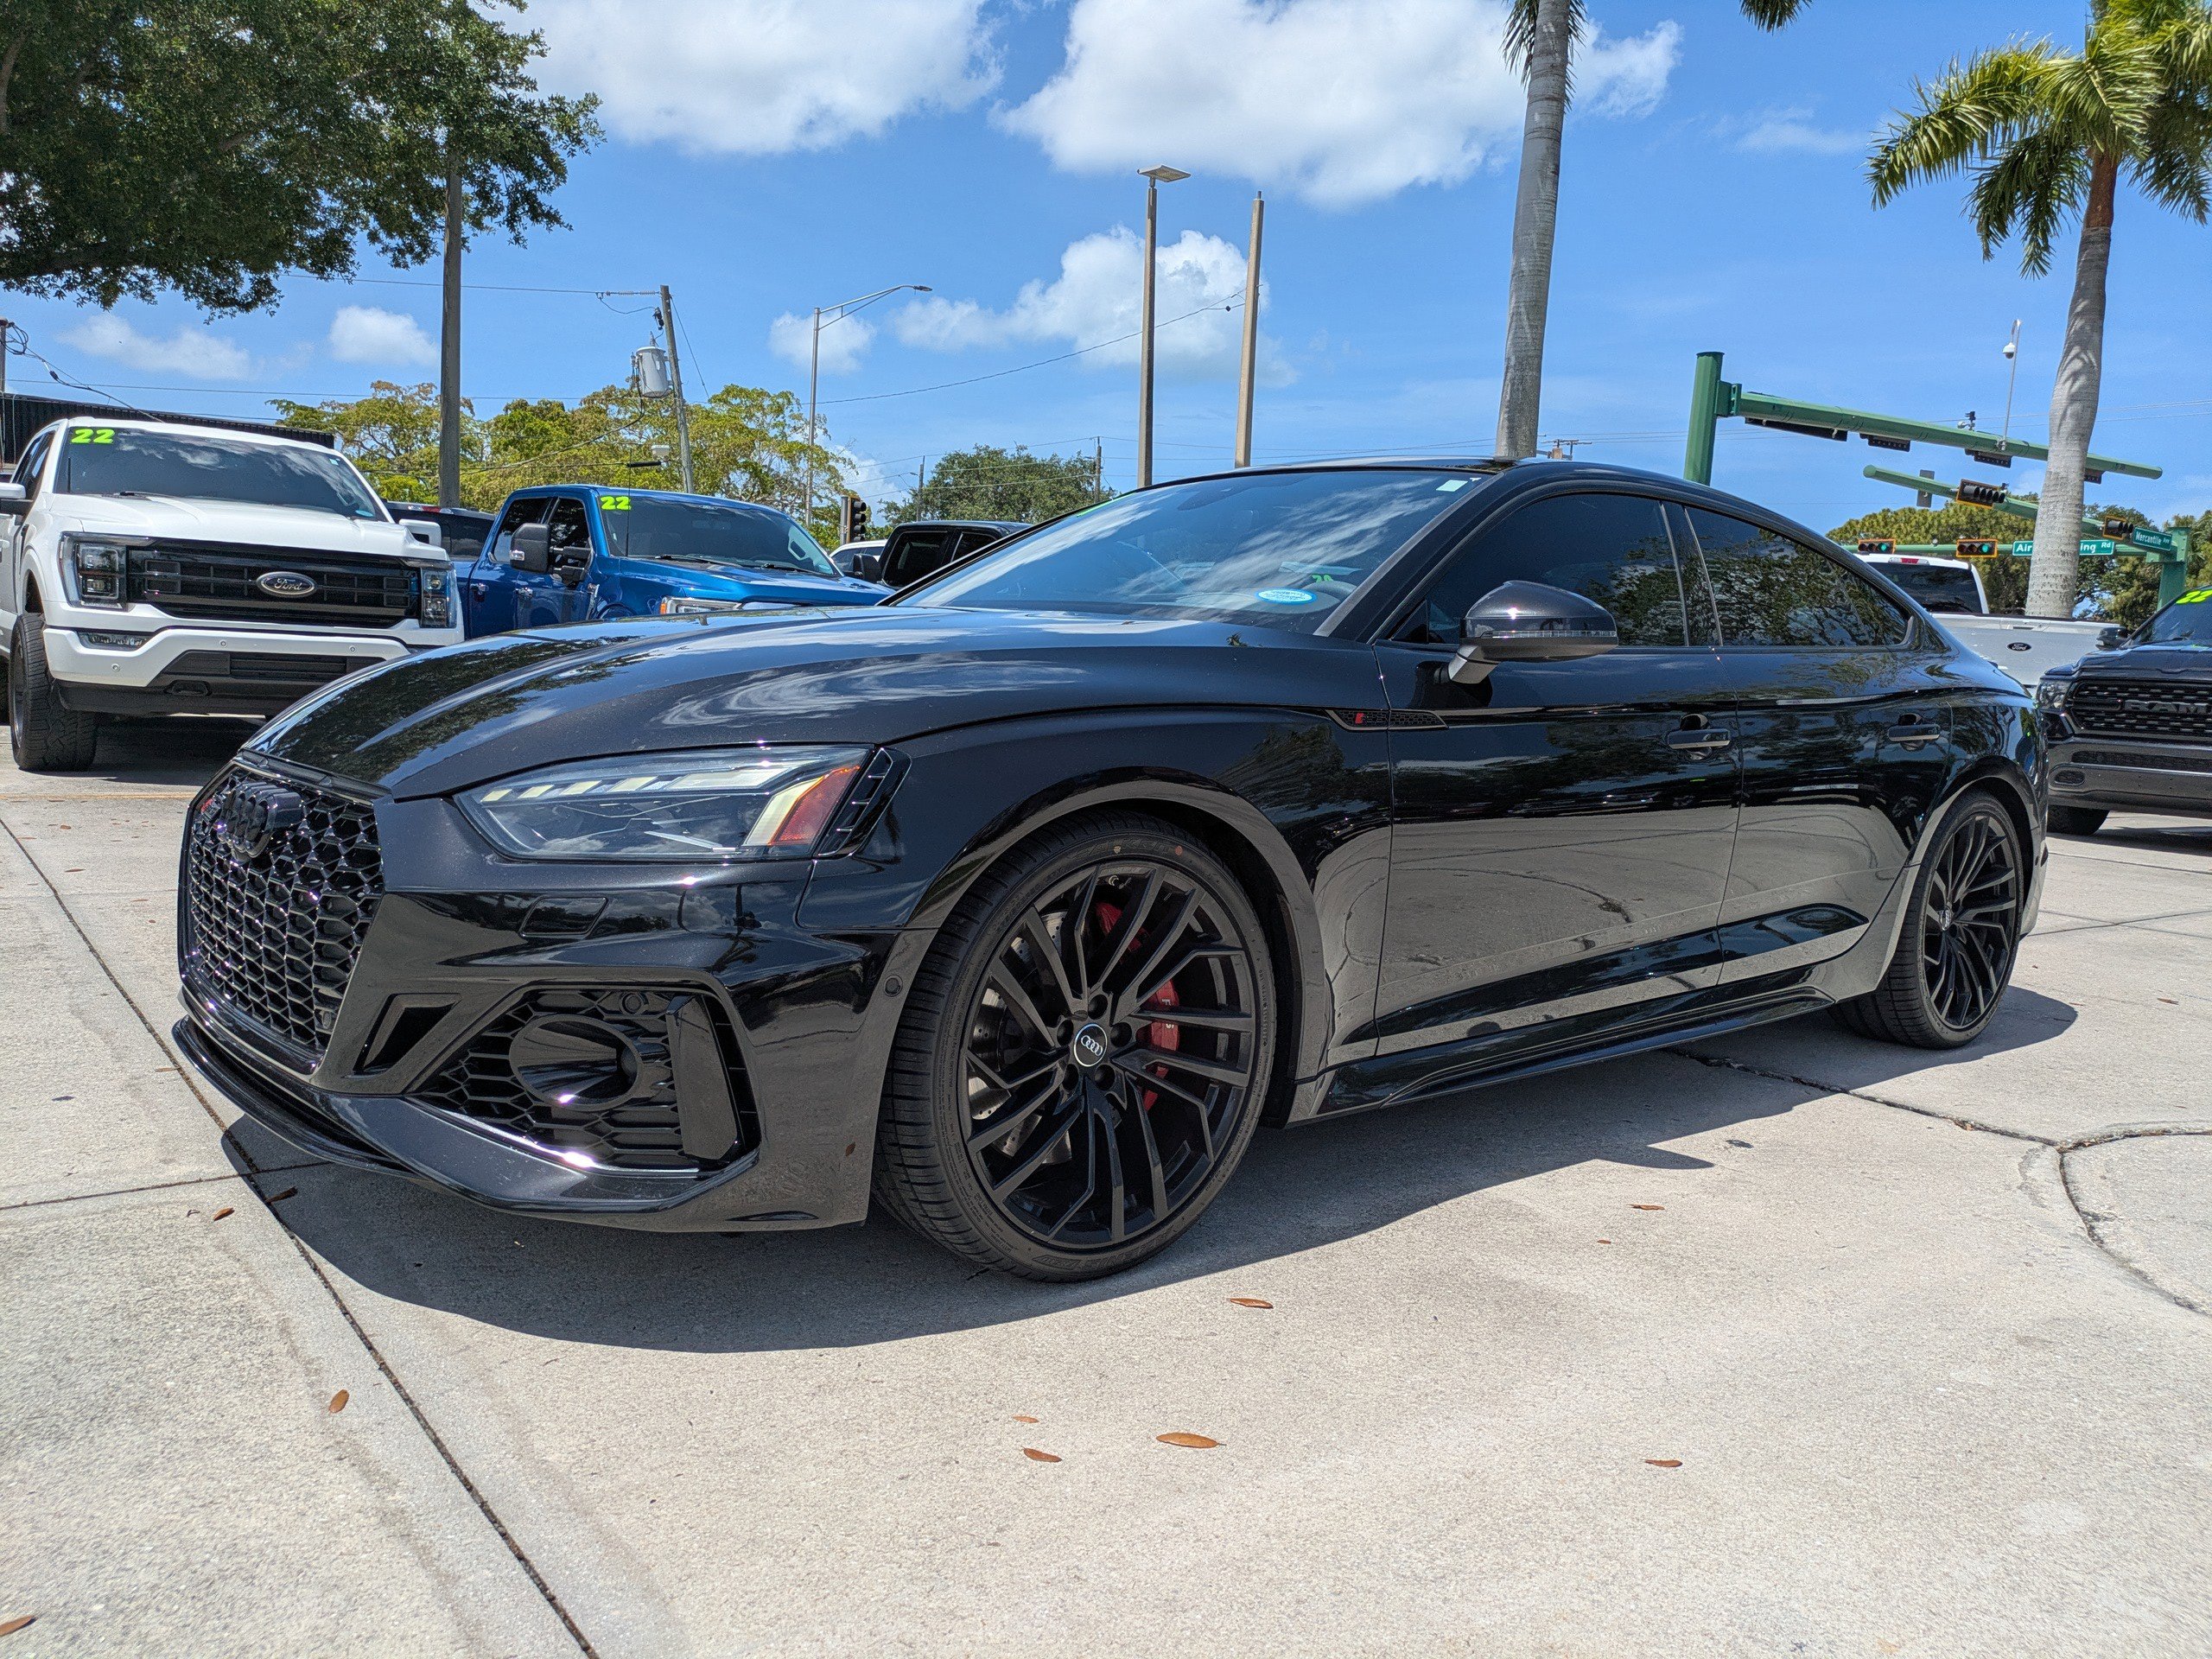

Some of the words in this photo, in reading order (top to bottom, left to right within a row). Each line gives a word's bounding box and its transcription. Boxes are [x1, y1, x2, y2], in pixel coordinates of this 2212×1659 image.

[71, 429, 115, 443] 22
[601, 496, 632, 510] 22
[2135, 531, 2162, 544] Mercantile
[2016, 543, 2033, 552] Air
[2080, 543, 2096, 553] ing
[274, 578, 302, 590] Ford
[2124, 699, 2209, 714] RAM
